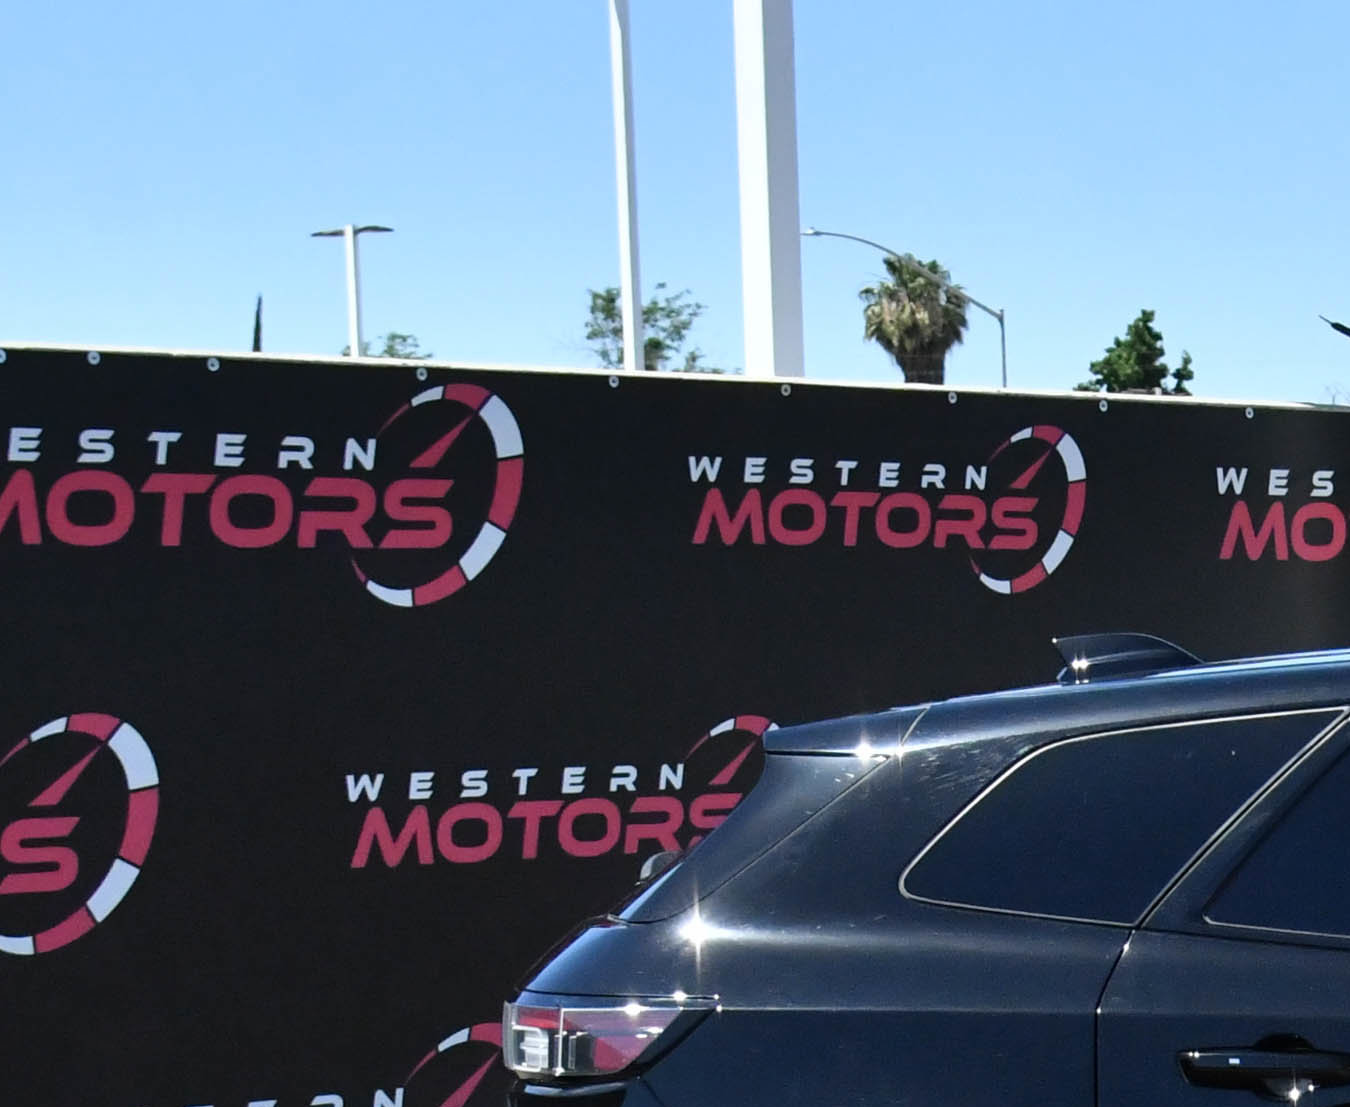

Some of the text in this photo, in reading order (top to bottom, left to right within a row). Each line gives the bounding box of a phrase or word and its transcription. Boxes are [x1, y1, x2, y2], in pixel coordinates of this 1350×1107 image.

[688, 455, 987, 490] WESTERN
[692, 487, 1038, 550] MOTORS
[346, 763, 685, 803] WESTERN
[351, 792, 743, 869] MOTORS
